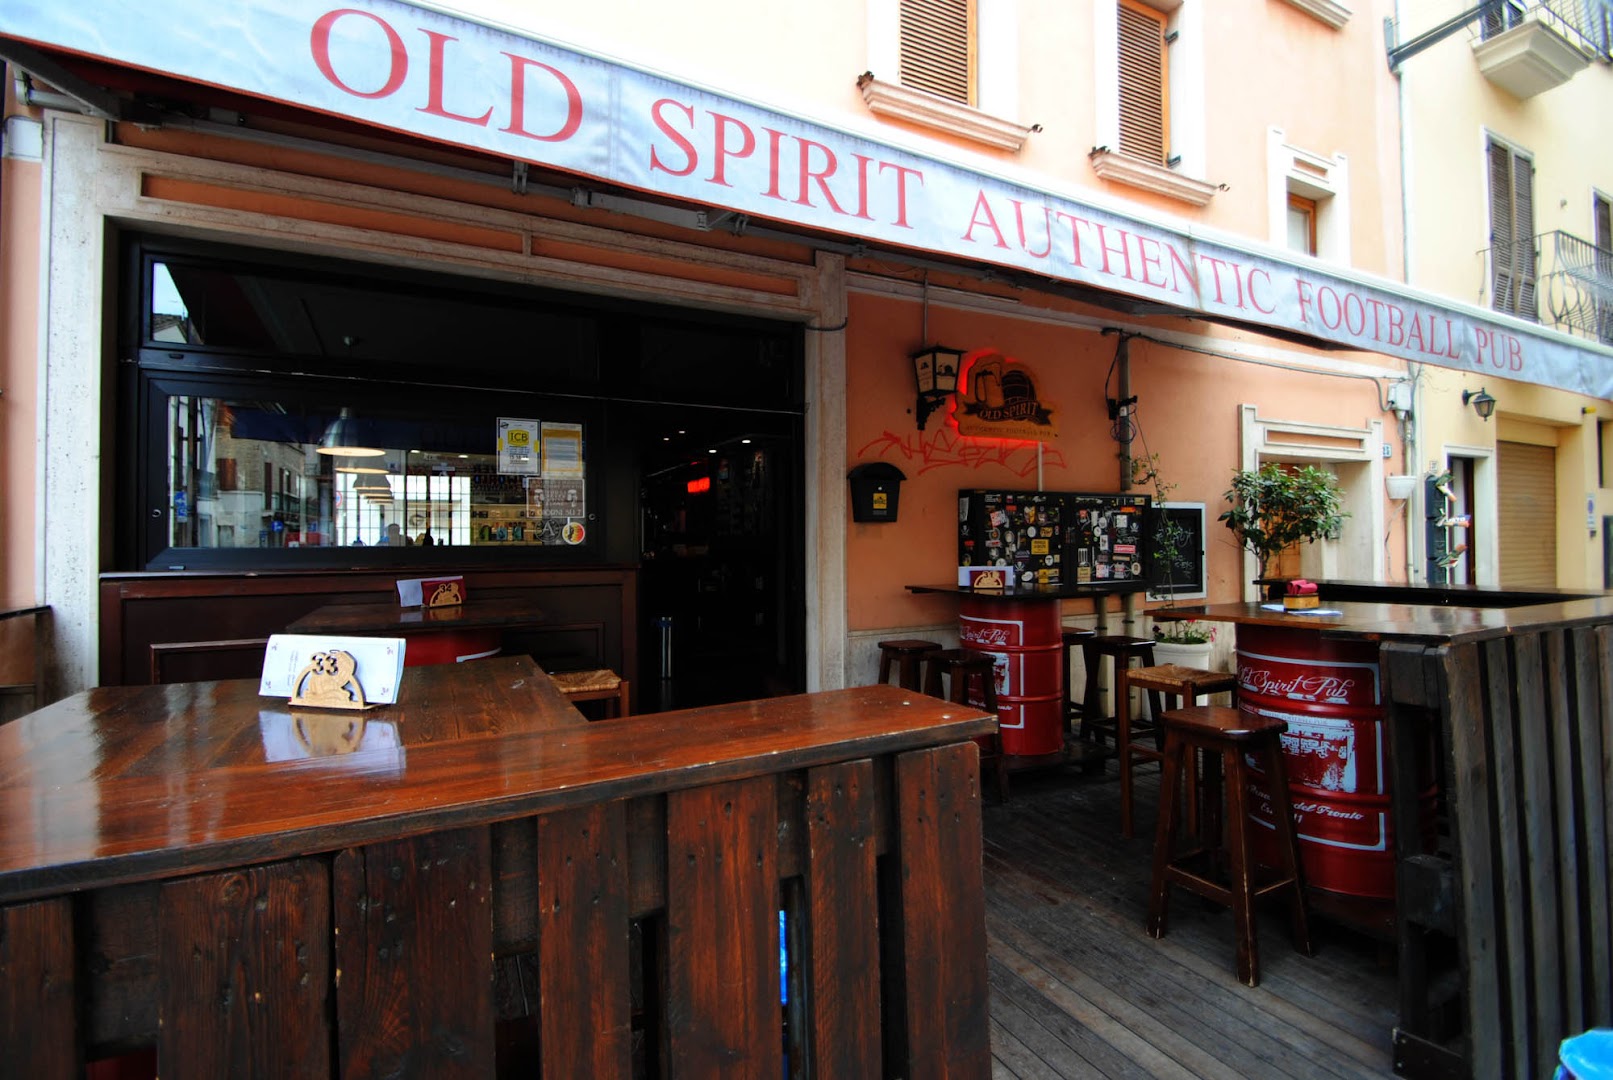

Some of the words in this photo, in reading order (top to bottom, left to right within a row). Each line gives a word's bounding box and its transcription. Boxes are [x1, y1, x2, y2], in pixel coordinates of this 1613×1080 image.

[310, 8, 584, 143] OLD
[649, 98, 924, 228] SPIRIT
[963, 188, 1276, 316] AUTHENTIC
[1297, 278, 1461, 361] FOOTBALL
[1475, 326, 1524, 373] PUB
[979, 407, 1002, 421] OLD
[1003, 402, 1039, 419] SPIRIT
[510, 432, 529, 441] ICB
[983, 571, 994, 579] 31
[440, 582, 452, 594] 34
[311, 654, 339, 676] 33
[1253, 670, 1304, 696] Spirit
[1303, 676, 1355, 698] Pub
[1293, 801, 1317, 813] del
[1316, 804, 1365, 821] Tronto
